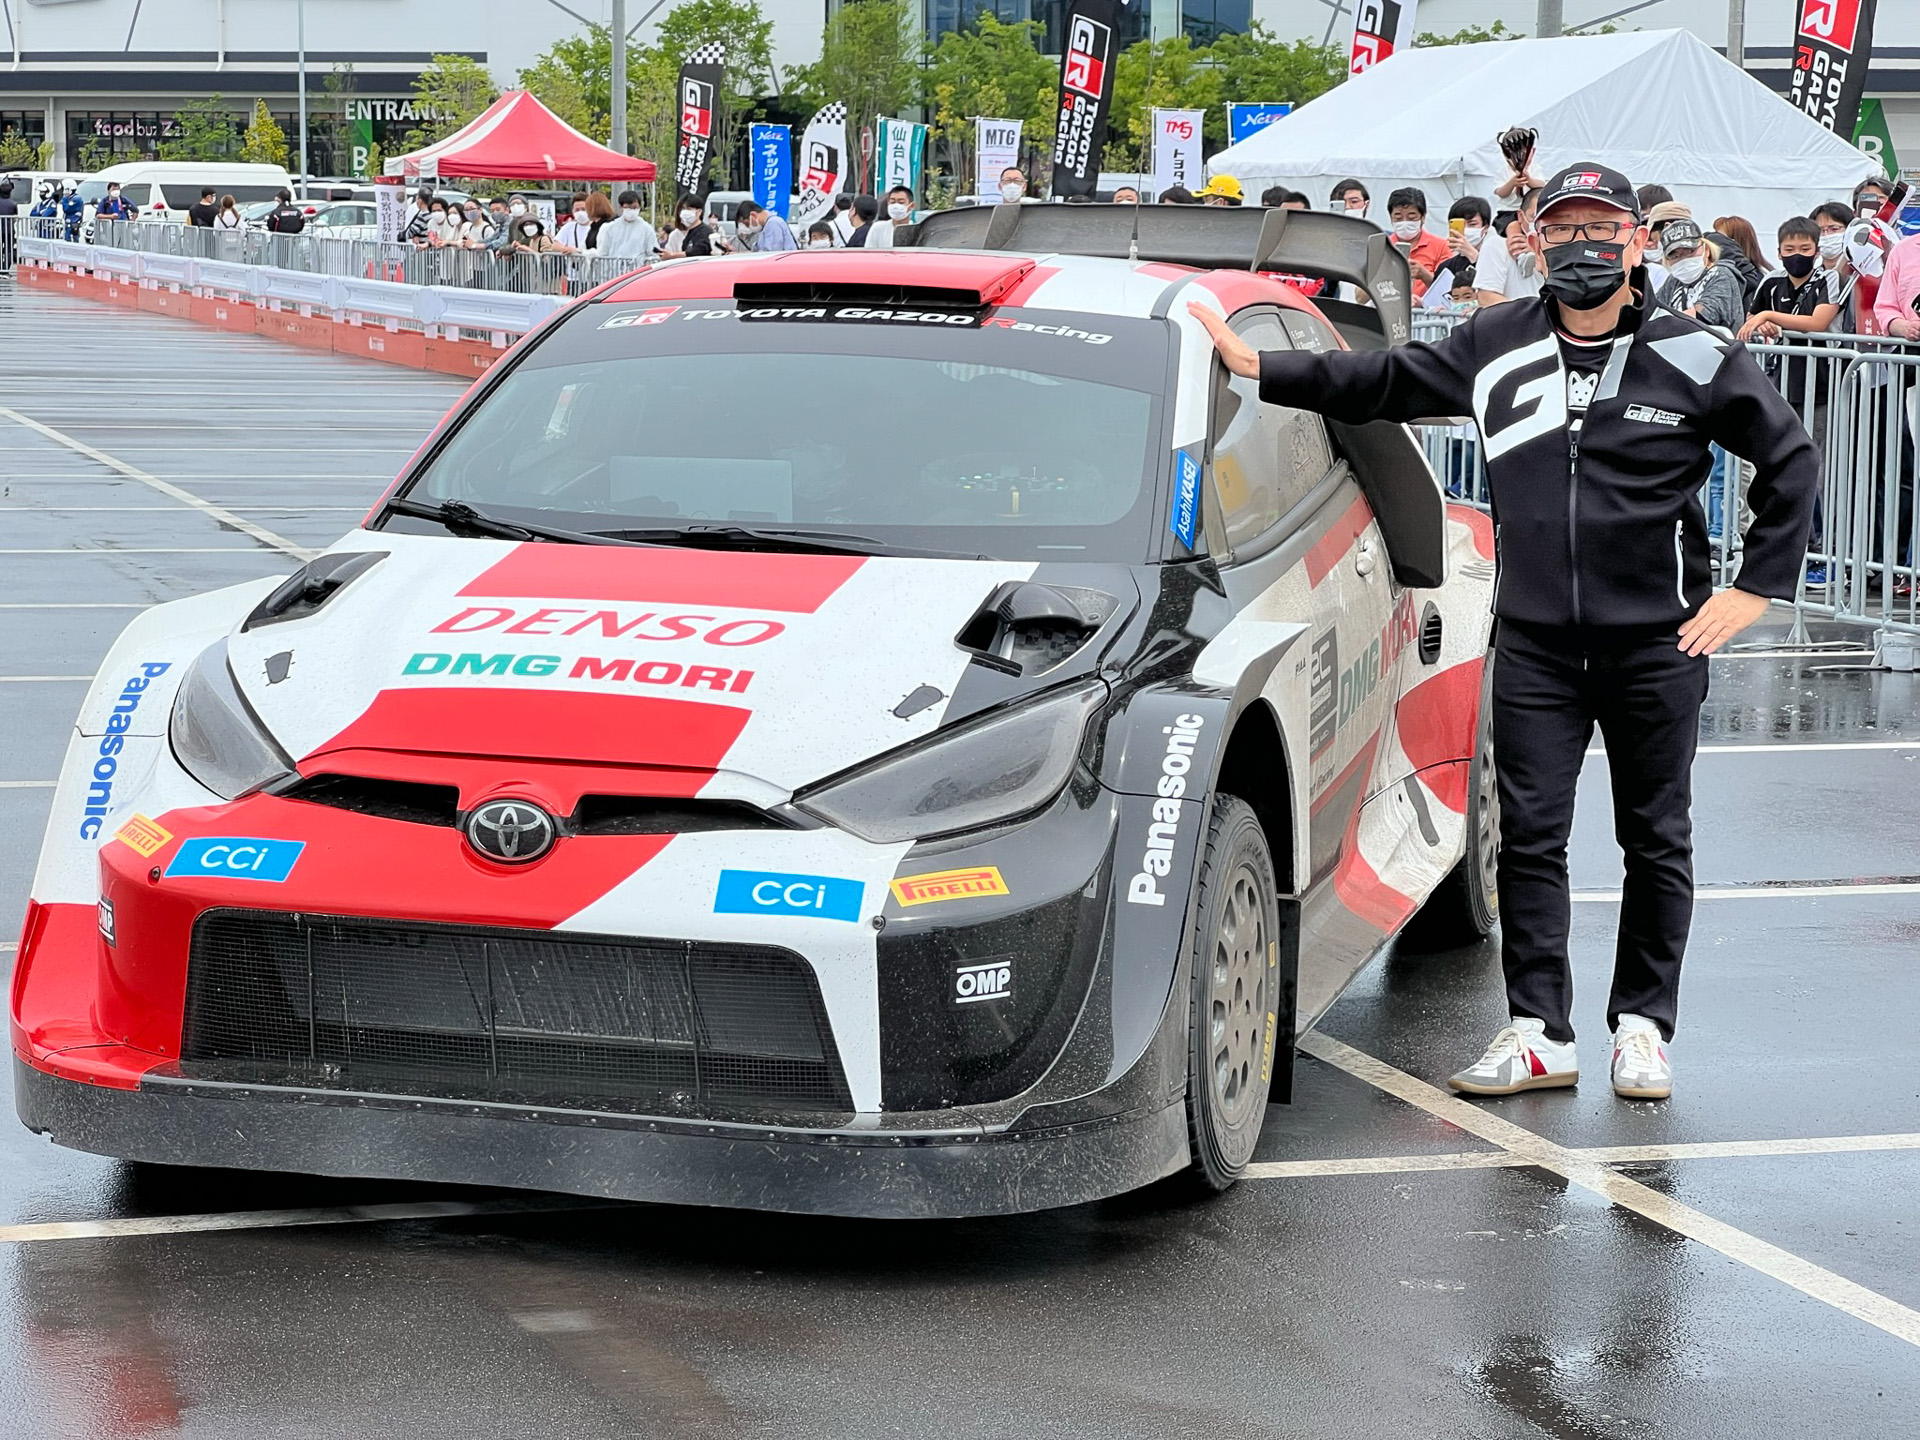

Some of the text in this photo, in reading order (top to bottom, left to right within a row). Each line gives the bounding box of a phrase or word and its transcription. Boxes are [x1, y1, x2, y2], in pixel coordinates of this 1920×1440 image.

[1804, 0, 1838, 37] R
[1068, 19, 1097, 89] GR
[1791, 45, 1814, 106] Rac
[683, 80, 703, 132] GR
[1805, 50, 1830, 117] GAZ
[1821, 59, 1848, 132] TOYO
[986, 128, 1015, 145] MTG
[1065, 95, 1087, 169] GAZOO
[1075, 102, 1099, 179] TOYOTA
[353, 146, 368, 170] B
[892, 127, 907, 187] 仙台トヨ
[1562, 174, 1600, 189] GR
[600, 307, 1113, 345] GR TOYOTA GAZOO Racing
[1625, 406, 1654, 422] GR
[428, 606, 786, 647] DENSO
[401, 653, 755, 694] DMG MORI
[1338, 588, 1419, 731] DMG MORI
[80, 662, 173, 841] Panasonic
[1127, 713, 1205, 906] Panasonic
[119, 817, 165, 851] PIRELLI
[899, 872, 997, 901] PIRELLI
[956, 967, 1011, 997] OMP
